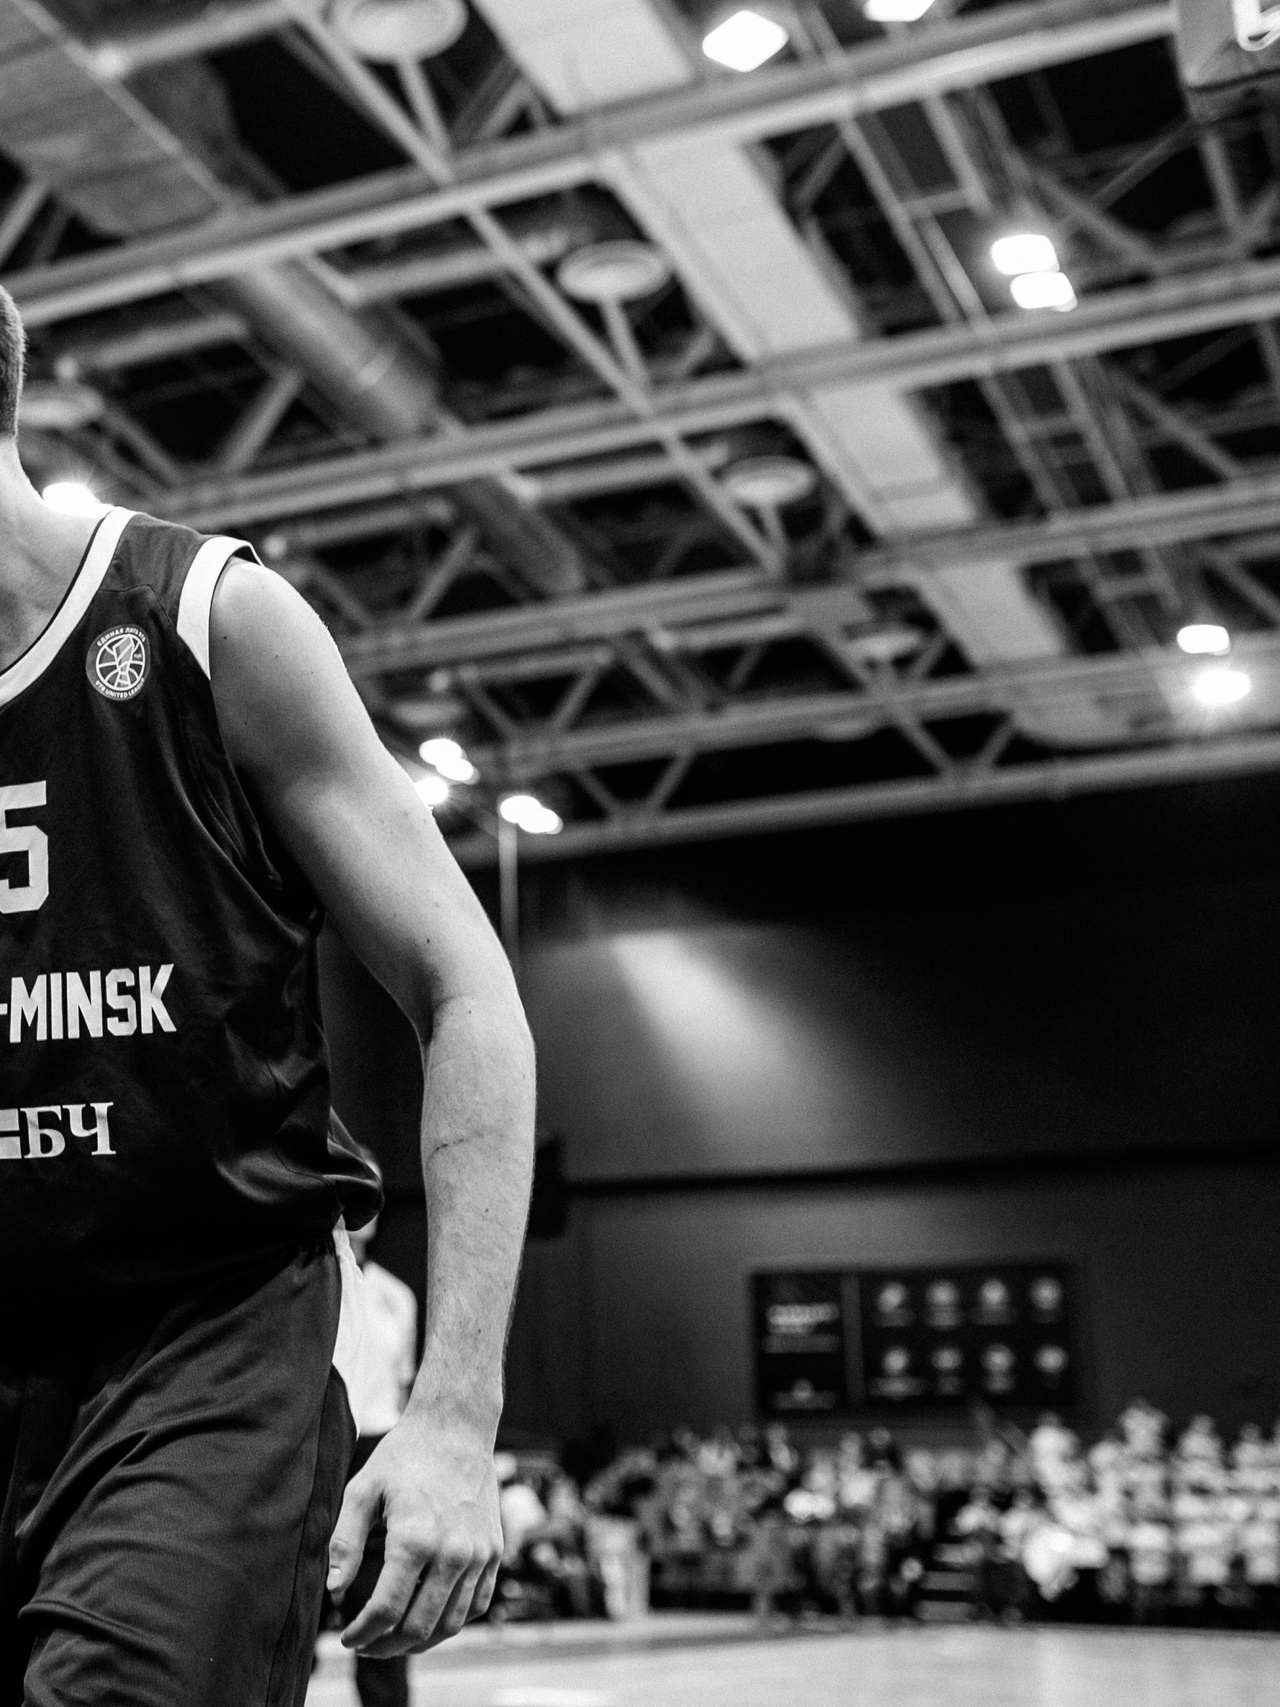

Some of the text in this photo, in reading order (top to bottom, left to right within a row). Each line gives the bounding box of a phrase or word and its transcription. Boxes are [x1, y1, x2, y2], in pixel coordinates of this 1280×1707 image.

[95, 679, 106, 692] VTB
[105, 688, 128, 699] UNITED
[19, 1101, 117, 1160] БЧ
